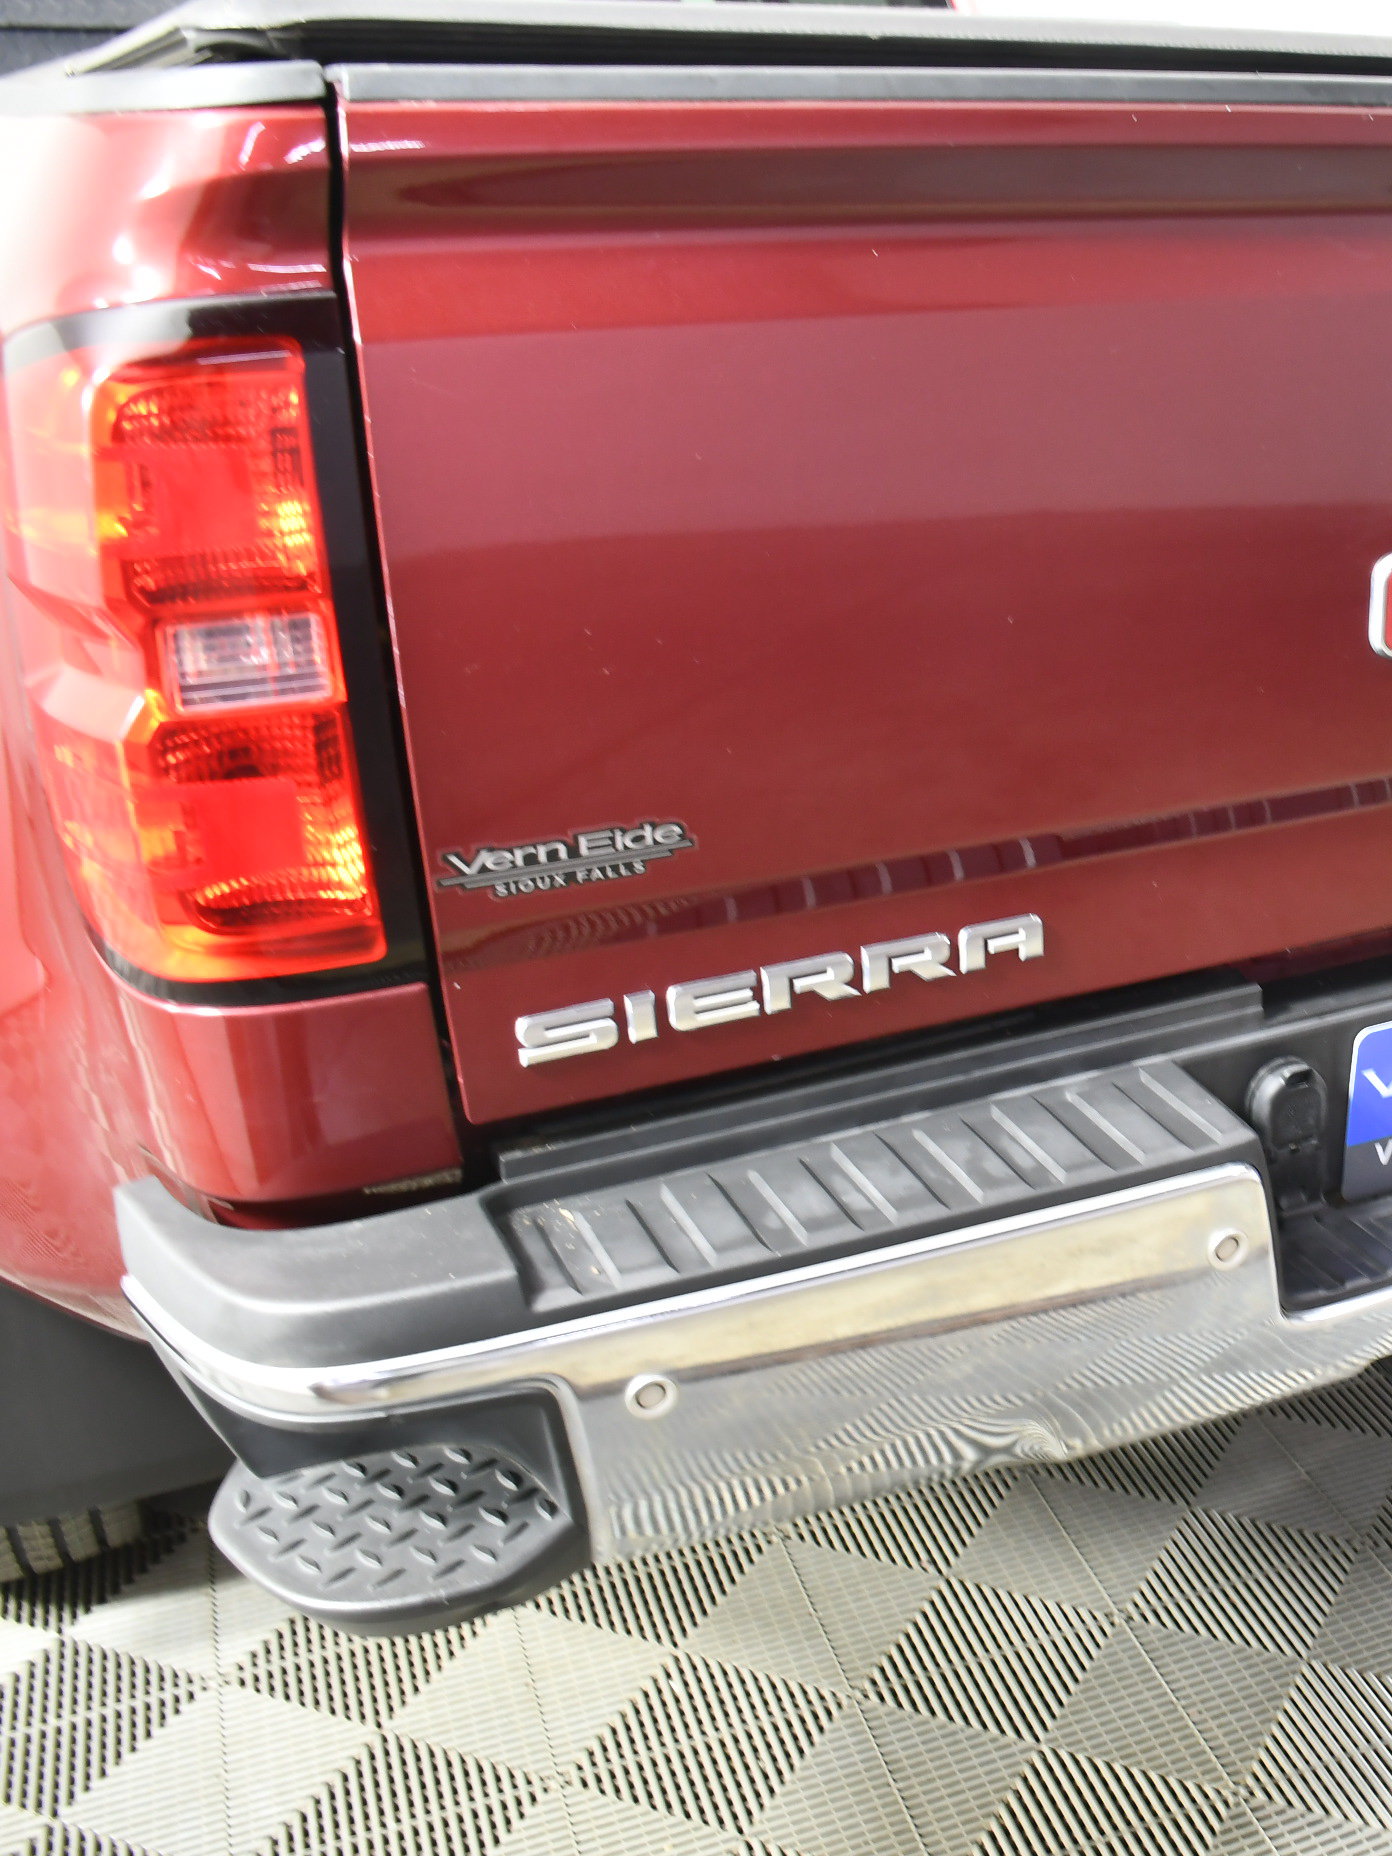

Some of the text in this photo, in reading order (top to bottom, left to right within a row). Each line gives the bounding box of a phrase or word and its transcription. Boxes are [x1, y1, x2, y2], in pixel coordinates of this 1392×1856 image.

[445, 822, 684, 876] Vern Eide
[494, 858, 647, 898] SIOUX FALLS
[515, 912, 1044, 1067] SIERRA
